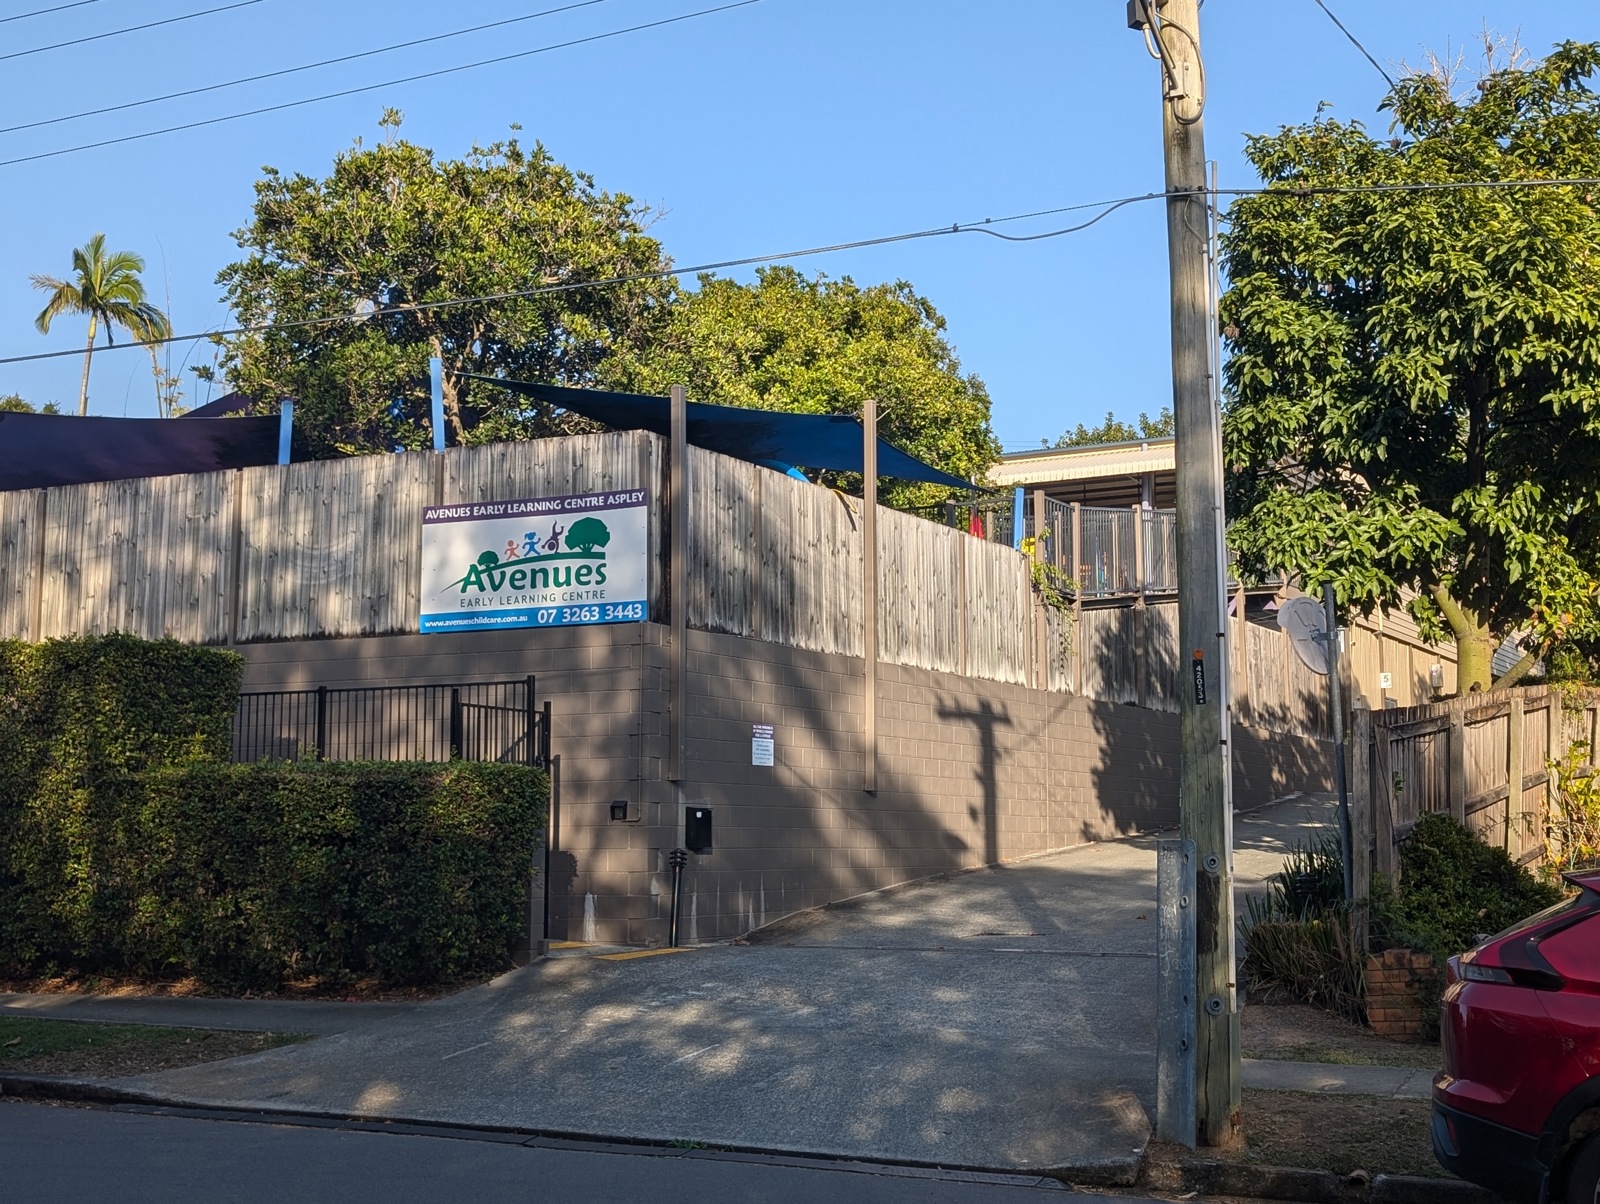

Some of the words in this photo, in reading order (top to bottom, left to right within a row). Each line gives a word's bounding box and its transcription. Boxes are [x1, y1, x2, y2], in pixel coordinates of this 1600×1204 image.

[425, 507, 471, 520] AVENUES
[473, 504, 506, 516] EARLY
[507, 500, 562, 513] LEARNING
[564, 496, 605, 509] CENTRE
[607, 492, 645, 505] ASPLEY
[460, 562, 607, 594] Avenues
[460, 596, 494, 608] EARLY
[499, 593, 556, 606] LEARNING
[562, 589, 606, 602] CENTRE
[424, 615, 528, 628] www.avenueschildcare.com.au
[537, 609, 557, 624] 07
[562, 606, 600, 623] 3263
[604, 603, 643, 620] 3443
[1383, 674, 1389, 683] 5
